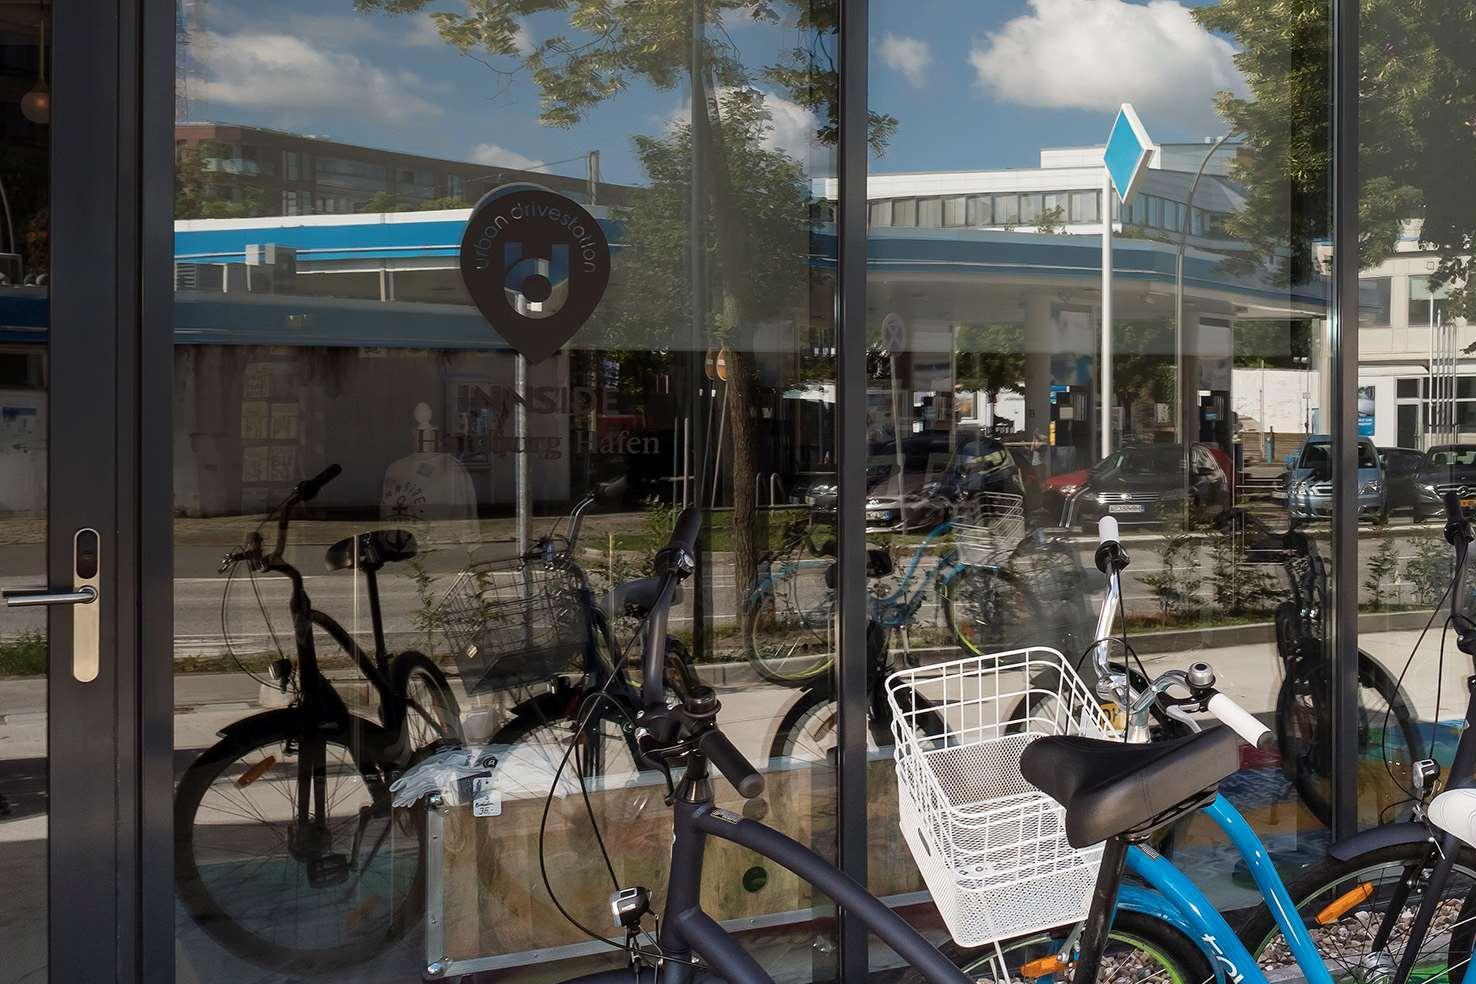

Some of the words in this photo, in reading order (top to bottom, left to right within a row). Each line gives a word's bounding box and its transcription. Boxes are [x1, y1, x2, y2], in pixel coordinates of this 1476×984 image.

[473, 215, 509, 272] urban
[511, 203, 597, 273] drivestation
[576, 431, 661, 455] Hafen
